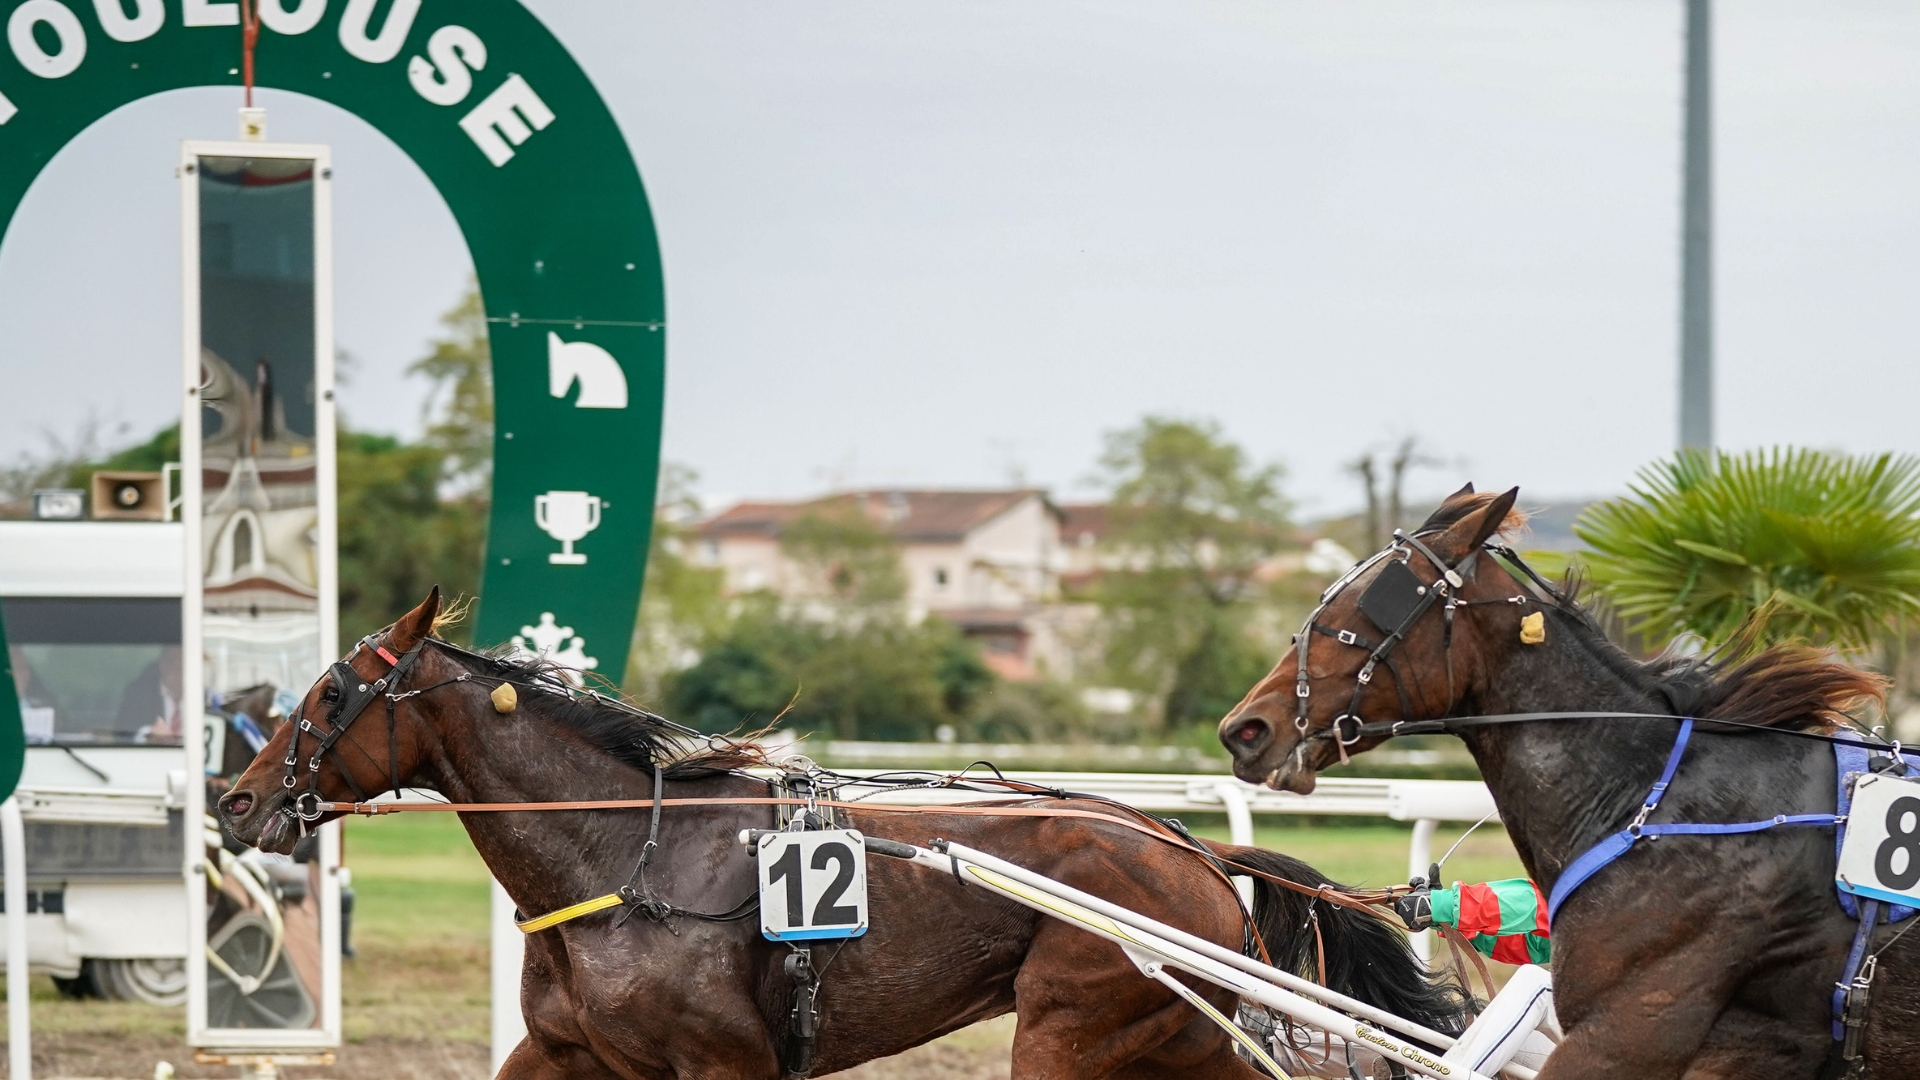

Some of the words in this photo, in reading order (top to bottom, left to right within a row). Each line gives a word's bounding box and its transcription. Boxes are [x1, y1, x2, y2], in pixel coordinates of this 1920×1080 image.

[0, 0, 556, 167] OUUSE
[769, 842, 858, 927] 12
[1874, 796, 1920, 891] 8
[1401, 1046, 1450, 1075] Chrono
